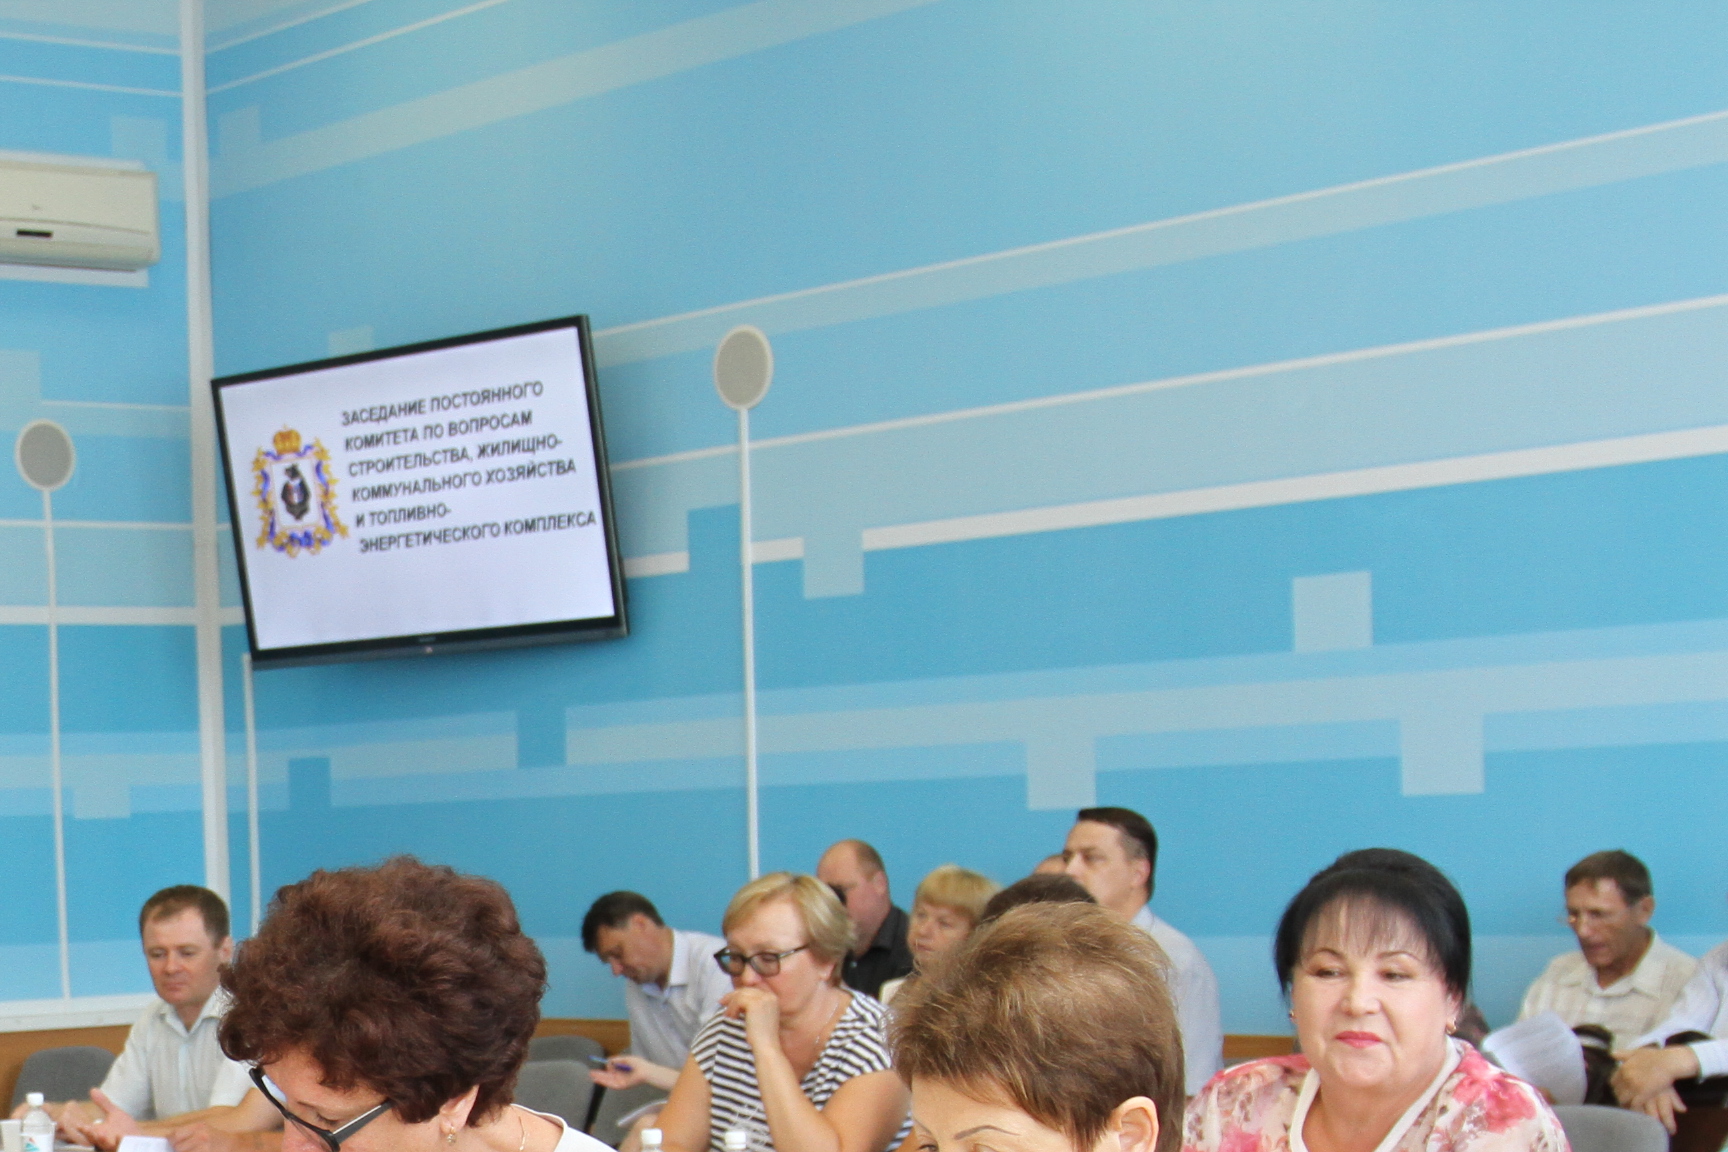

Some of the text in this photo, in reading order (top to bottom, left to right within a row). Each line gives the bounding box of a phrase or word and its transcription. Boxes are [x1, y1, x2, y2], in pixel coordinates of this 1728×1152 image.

[342, 380, 544, 426] ЗАСЕДАНИЕ ПОСТОЯННОГО
[345, 410, 533, 451] КОМИТЕТА ПО ВОПРОСАМ
[349, 434, 563, 478] СТРОИТЕЛЬСТВА, ЖИЛИЩНО-
[352, 458, 576, 501] КОММУНАЛЬНОГО ХОЗЯЙСТВА
[356, 502, 452, 528] И ТОПЛИВНО-
[360, 511, 596, 552] ЭНЕРГЕТИЧЕСКОГО КОМПЛЕКСА
